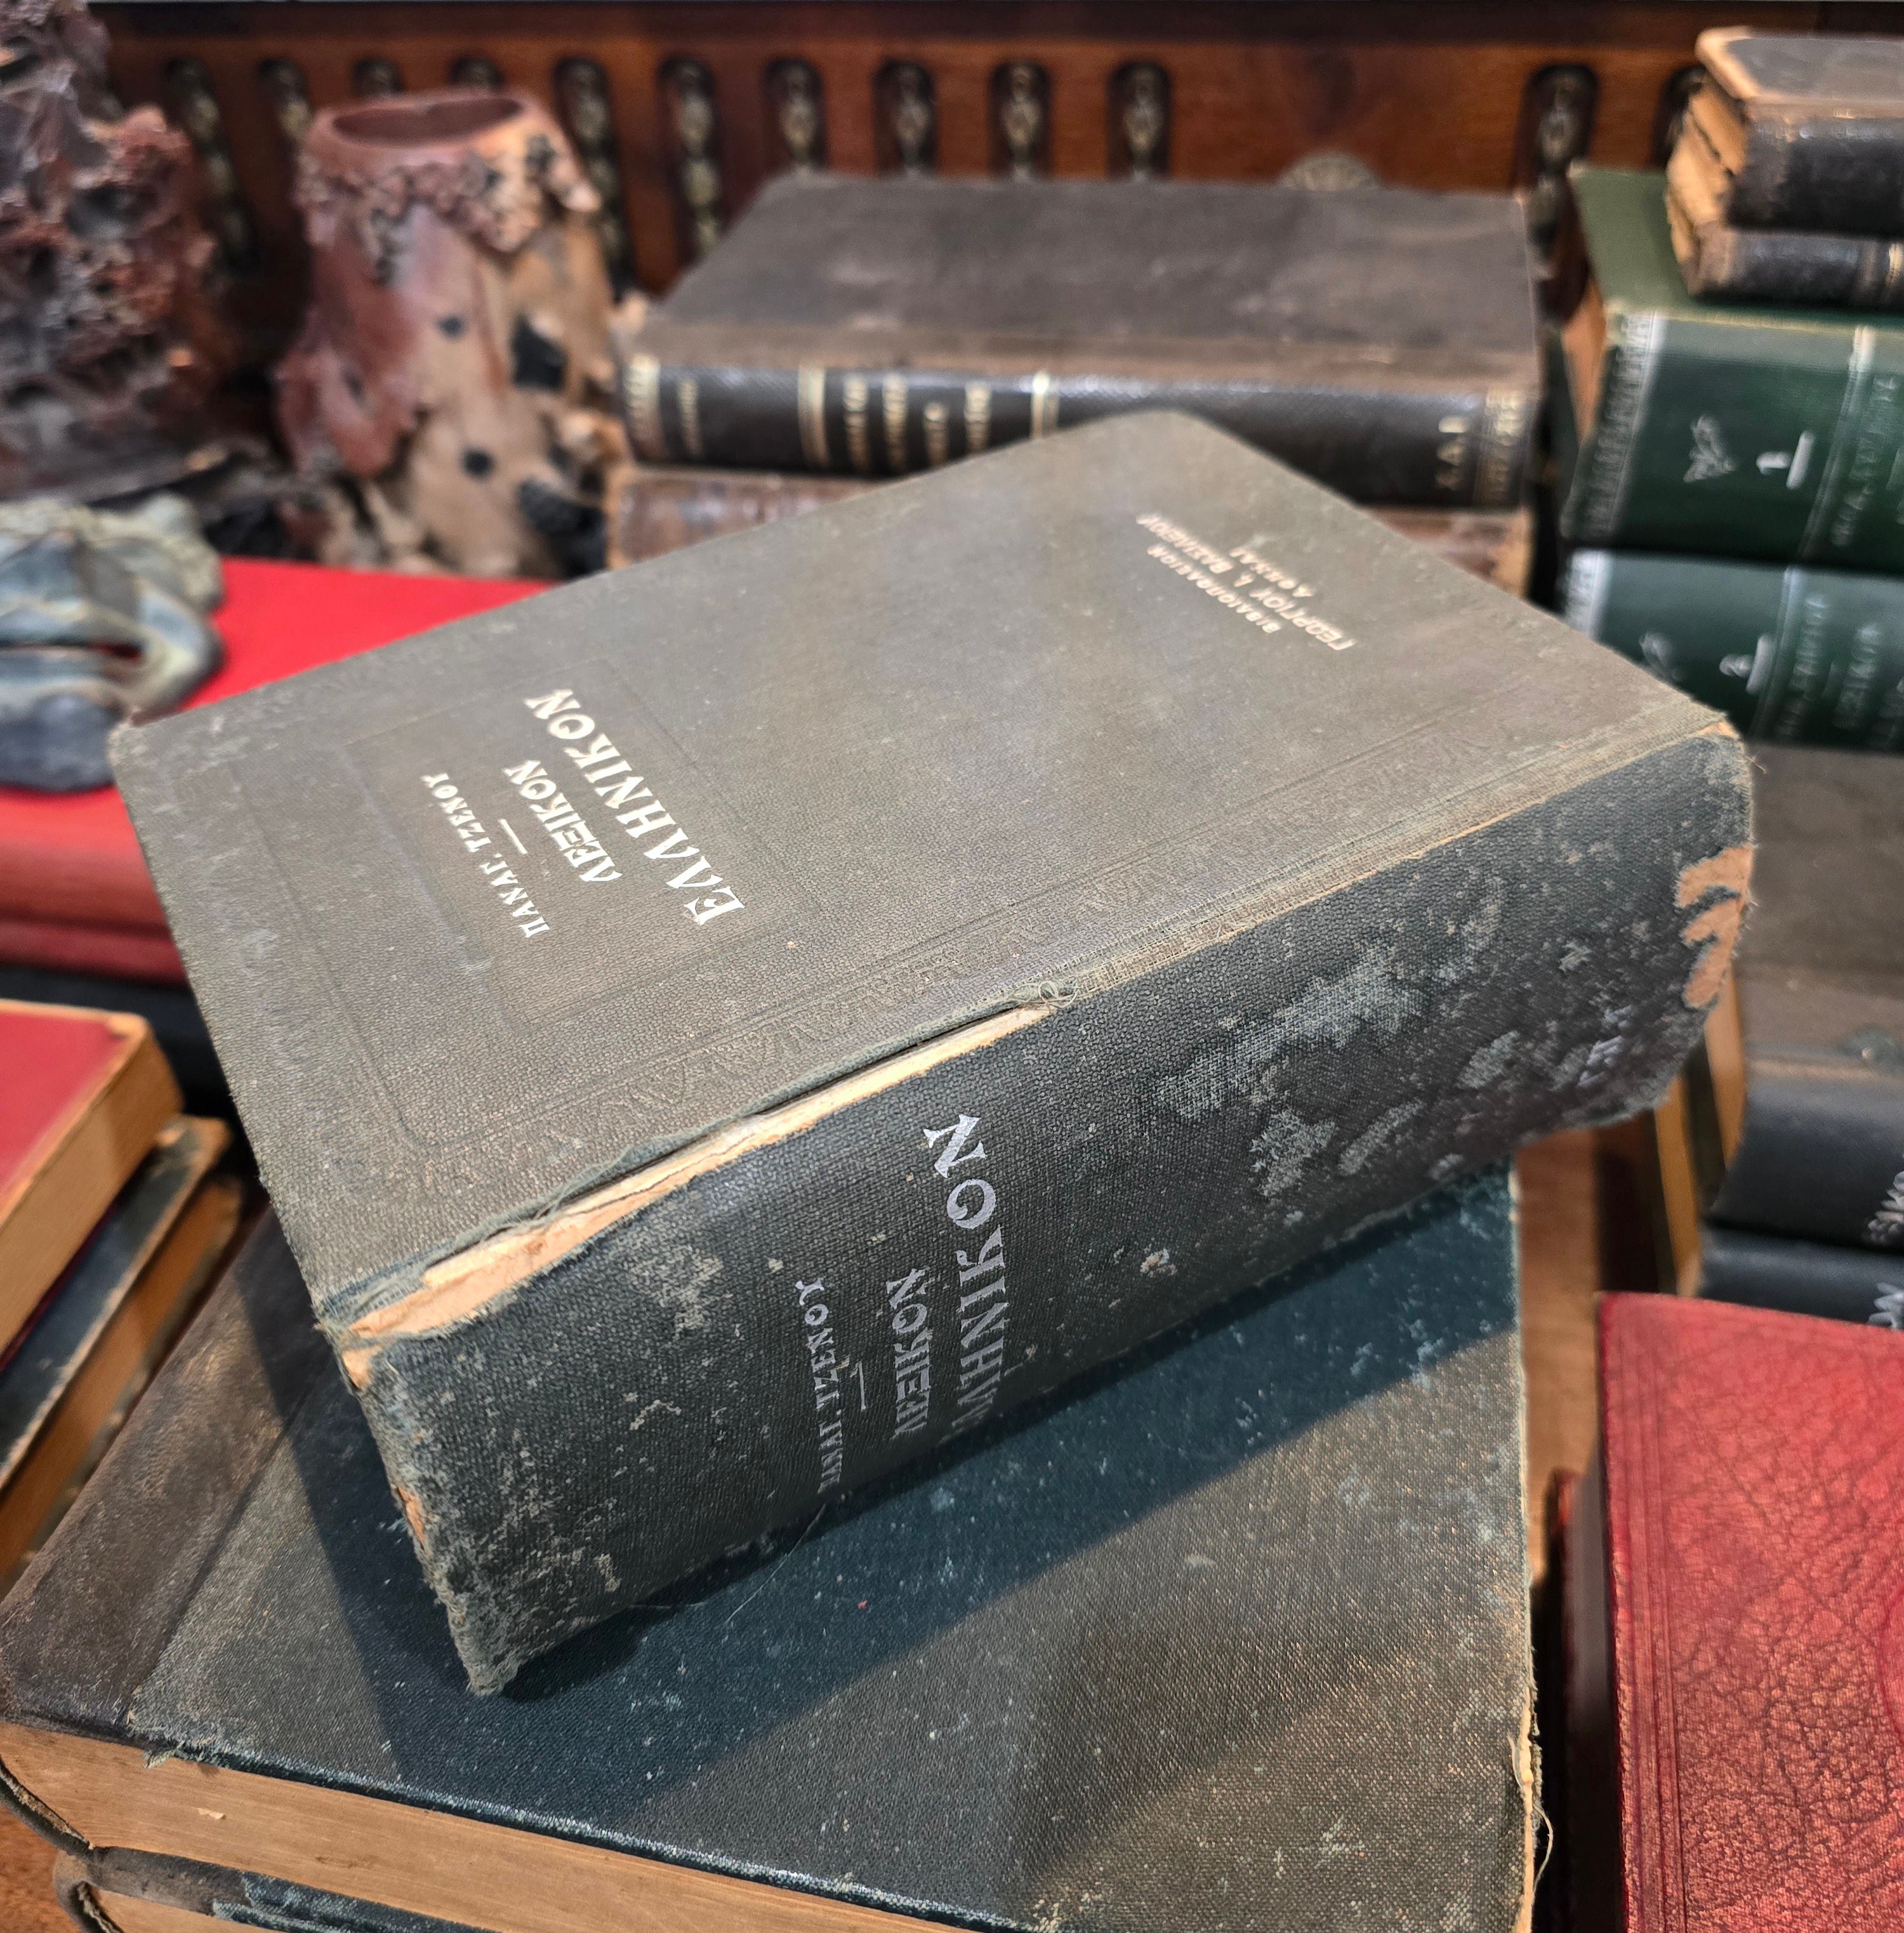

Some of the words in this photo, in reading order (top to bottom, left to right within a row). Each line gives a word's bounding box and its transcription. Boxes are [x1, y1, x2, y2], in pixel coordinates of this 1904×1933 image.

[1249, 587, 1356, 650] ΓΕΩΡΓΙΟΥ
[421, 773, 491, 853] ΤΖΕΝΟΥ
[503, 760, 623, 881] ΛΕΞΙΚΟΝ
[524, 689, 745, 926] ΕΛΛΗΝΙΚΟΝ
[480, 853, 550, 938] ΠΑΝΑΓ.
[923, 1114, 1007, 1444] ΛΛΗΝΙΚΟΝ
[795, 1277, 840, 1410] ΤΖΕΝΟΥ
[887, 1268, 931, 1438] ΛΕΞΙΚΟΝ
